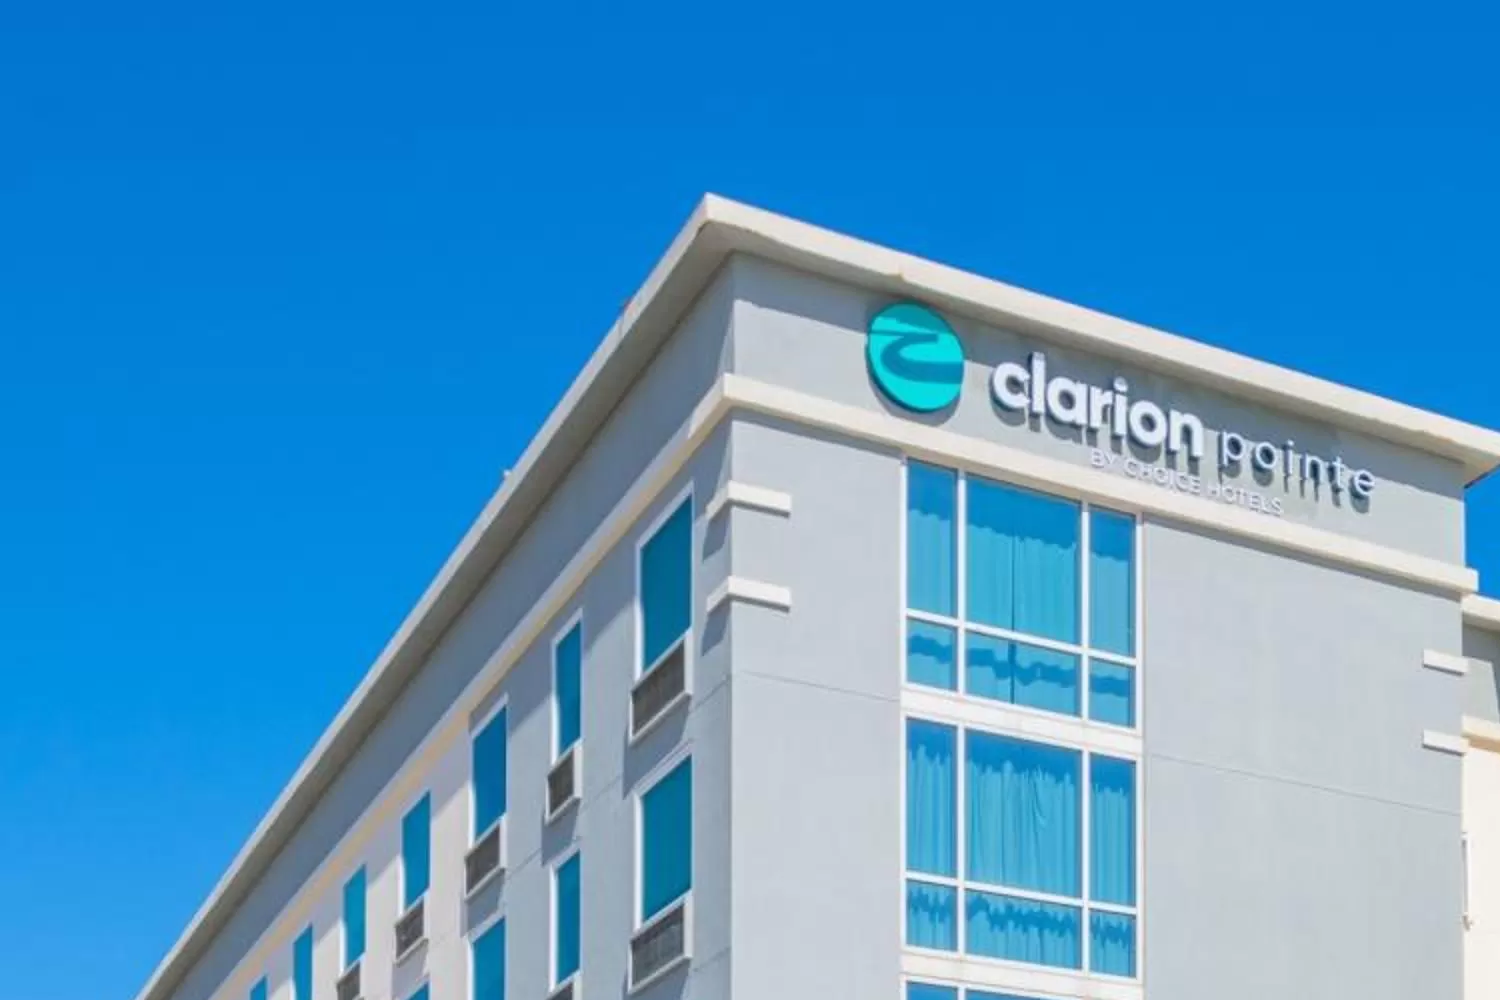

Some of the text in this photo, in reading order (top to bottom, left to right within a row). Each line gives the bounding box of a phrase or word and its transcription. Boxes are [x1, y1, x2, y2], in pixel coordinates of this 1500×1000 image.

[992, 352, 1376, 496] clarion pointe
[1091, 447, 1283, 517] BY CHOICE HOTELS
